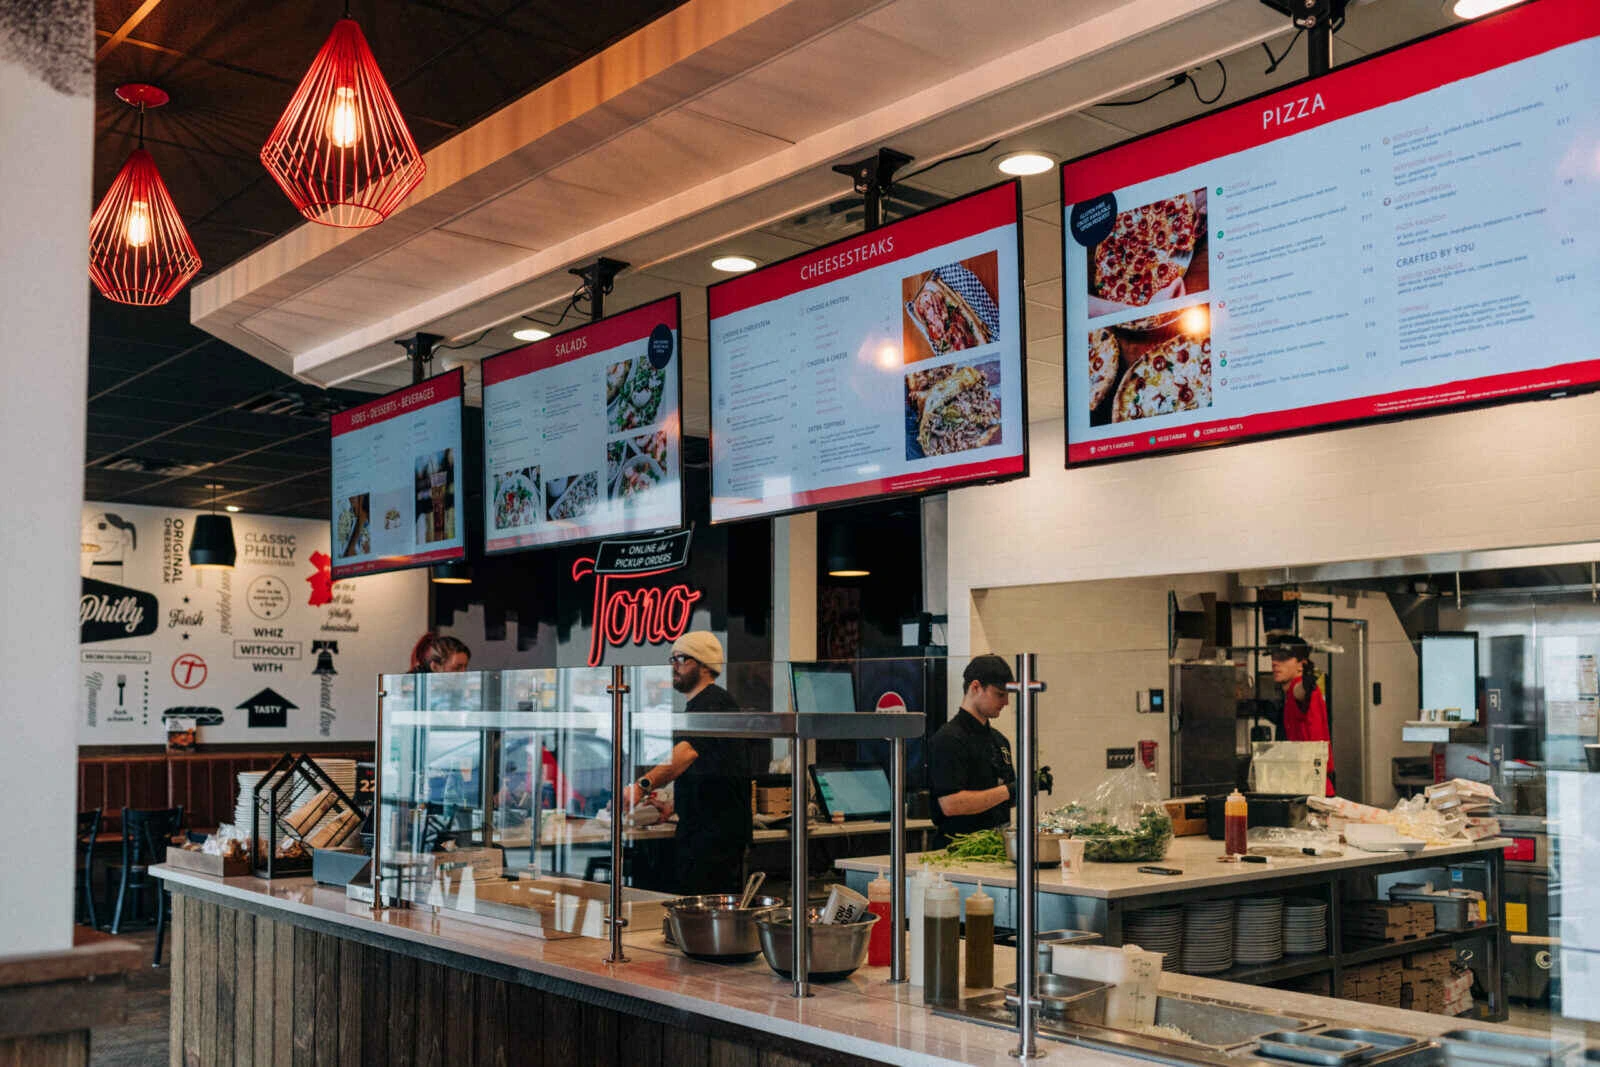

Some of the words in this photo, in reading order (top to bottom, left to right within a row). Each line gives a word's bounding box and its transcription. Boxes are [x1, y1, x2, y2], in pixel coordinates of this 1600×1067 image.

[1262, 92, 1326, 130] PIZZA
[800, 236, 895, 281] CHEESESTEAKS
[1396, 250, 1437, 268] CRAFTED
[1440, 248, 1451, 258] BY
[1455, 243, 1474, 253] YOU
[555, 336, 588, 357] SALADS
[351, 411, 366, 425] SIDES
[369, 399, 398, 419] DESSERTS
[401, 387, 435, 408] BEVERAGES
[1157, 432, 1187, 442] VEGETARIAN
[1203, 425, 1228, 435] CONTAINS
[244, 532, 297, 545] CLASSIC
[164, 517, 172, 584] CHEESESTEAK
[172, 518, 184, 584] ORIGINAL
[244, 545, 297, 559] PHILLY
[628, 543, 657, 555] ONLINE
[614, 556, 643, 568] PICKUP
[644, 552, 672, 566] ORDERS
[80, 594, 144, 633] Philly
[168, 608, 204, 628] Fresh
[572, 557, 702, 667] Tono
[254, 628, 284, 638] WHIZ
[240, 645, 296, 656] WITHOUT
[252, 662, 283, 673] WITH
[253, 705, 281, 714] TASTY
[833, 904, 846, 921] YOU
